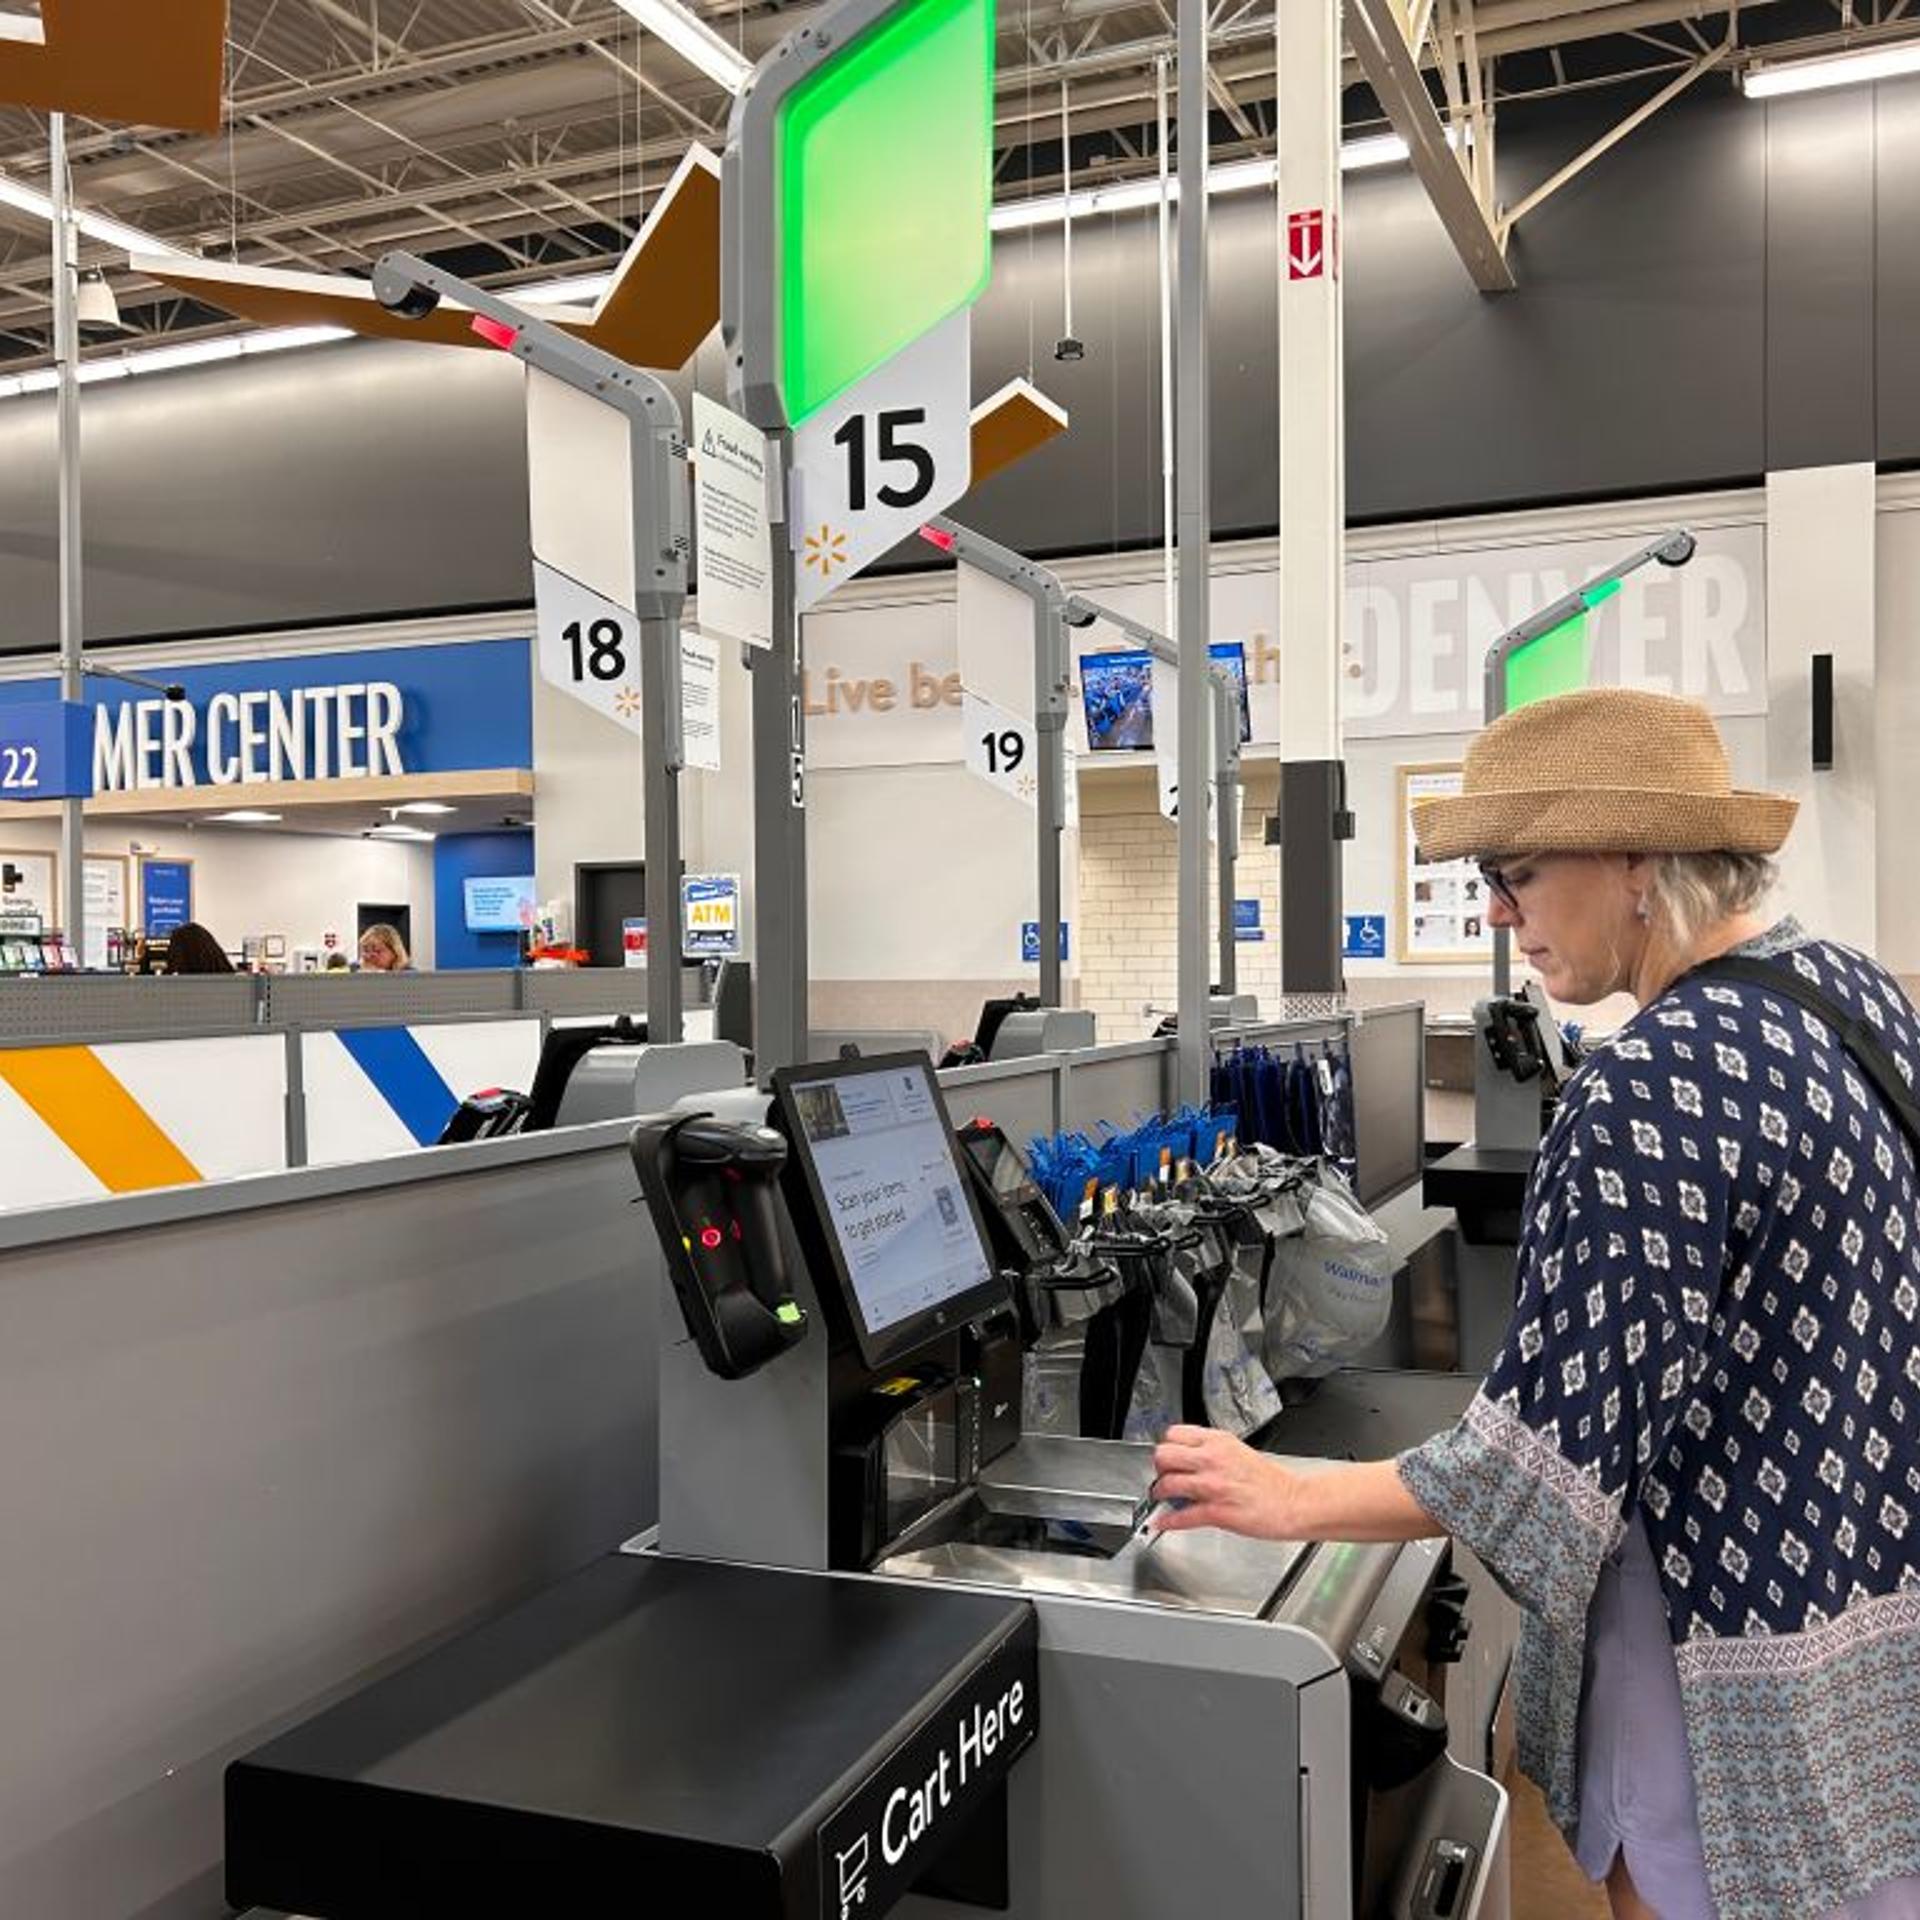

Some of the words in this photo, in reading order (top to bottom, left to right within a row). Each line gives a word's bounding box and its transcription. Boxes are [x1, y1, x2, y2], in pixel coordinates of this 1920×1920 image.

[834, 407, 936, 511] 15
[562, 618, 626, 681] 18
[802, 665, 898, 717] Live
[207, 681, 405, 786] CENTER
[981, 730, 1025, 773] 19
[2, 746, 39, 788] 22
[692, 903, 731, 924] ATM
[881, 1749, 952, 1866] Cart
[958, 1679, 1024, 1786] Here
